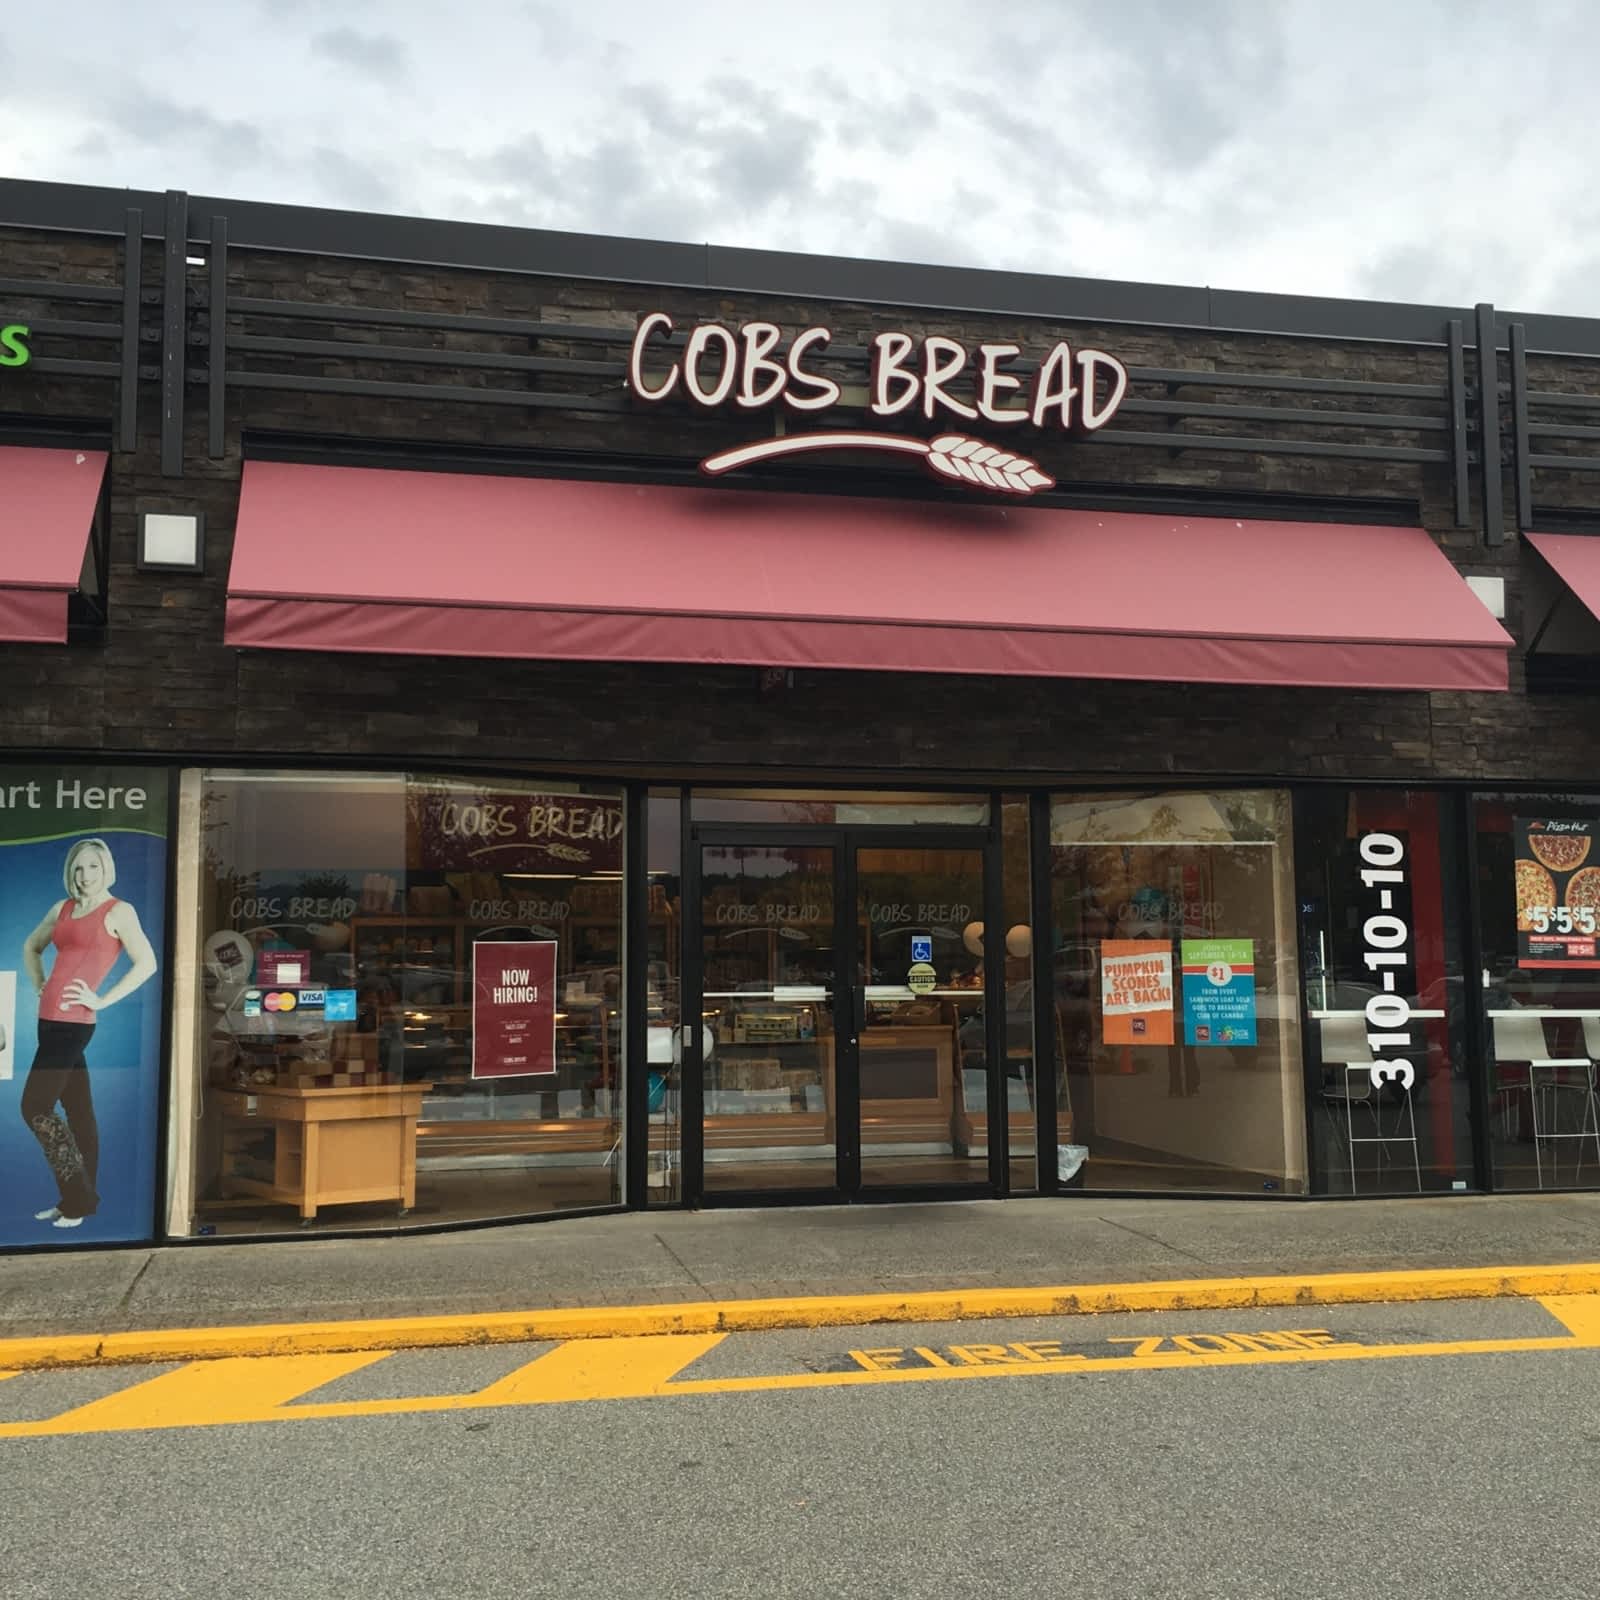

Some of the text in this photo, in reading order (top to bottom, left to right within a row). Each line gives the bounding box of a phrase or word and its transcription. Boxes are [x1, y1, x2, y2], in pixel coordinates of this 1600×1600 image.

[632, 313, 1128, 430] COBS BREAD
[56, 779, 147, 810] Here
[440, 803, 624, 840] COBS BREAD
[1546, 820, 1570, 831] Pizza
[230, 896, 357, 920] COBS BREAD
[469, 899, 570, 921] COBS BREAD
[716, 903, 821, 923] COBS BREAD
[870, 903, 971, 923] COBS BREAD
[1103, 959, 1165, 978] PUMPKIN
[1359, 832, 1415, 1090] 310-10-10
[501, 968, 530, 986] NOW
[1112, 974, 1161, 991] SCONES
[1211, 967, 1225, 981] $1
[302, 992, 323, 1001] VISA
[493, 986, 538, 1004] HIRING!
[1105, 988, 1171, 1007] ARE BACK!
[848, 1329, 1362, 1371] FIRE ZONE
